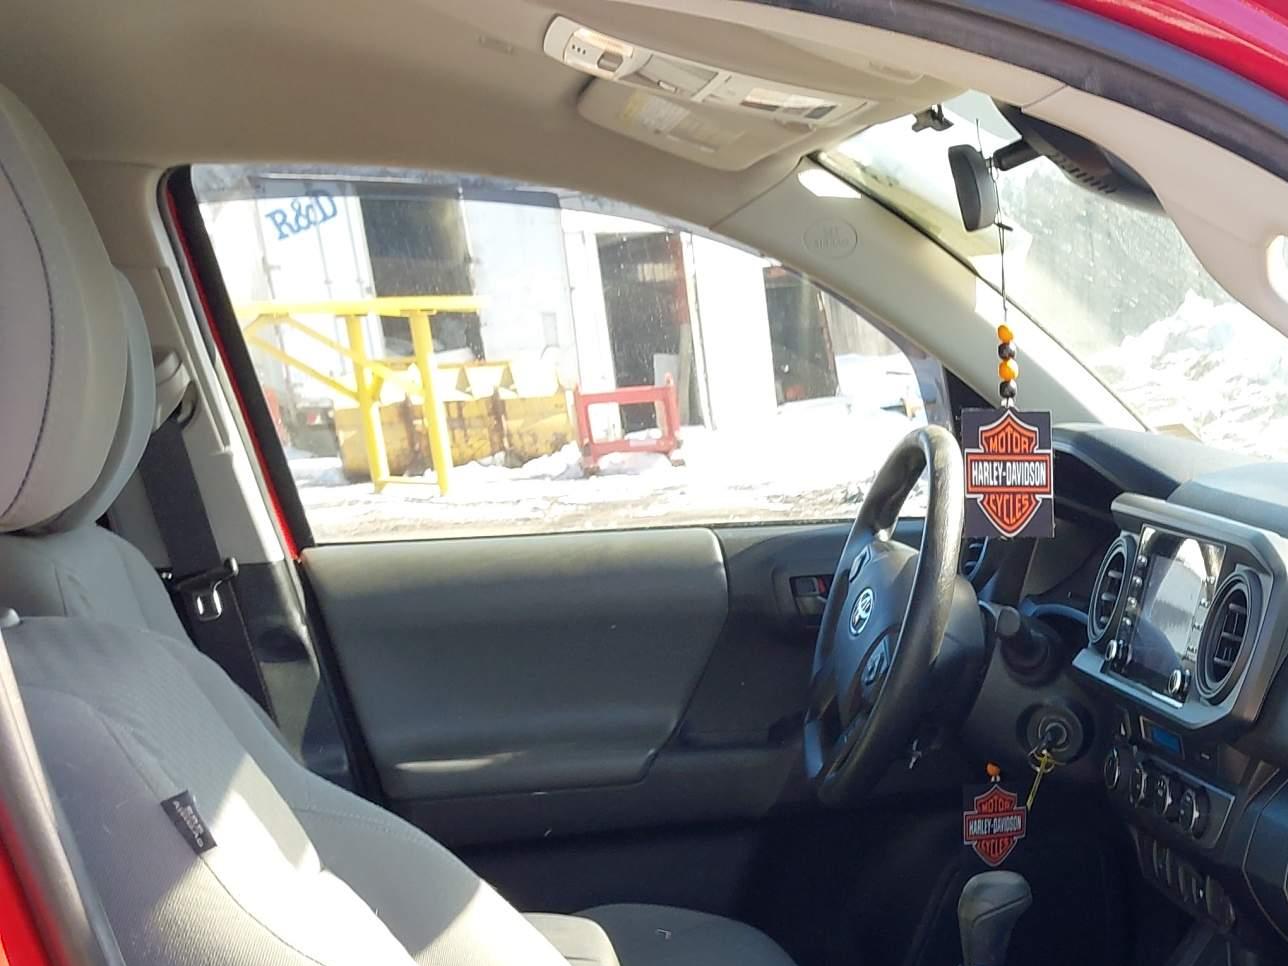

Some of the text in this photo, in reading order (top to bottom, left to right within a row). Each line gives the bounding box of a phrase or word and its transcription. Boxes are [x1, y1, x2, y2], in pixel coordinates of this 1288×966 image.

[264, 189, 338, 241] R&D
[989, 424, 1030, 454] MOTOR
[971, 460, 1047, 487] HARLEY-DAVIDSON
[989, 493, 1030, 525] CYCLES
[968, 815, 1022, 836] HARLEY-DAVIDSON
